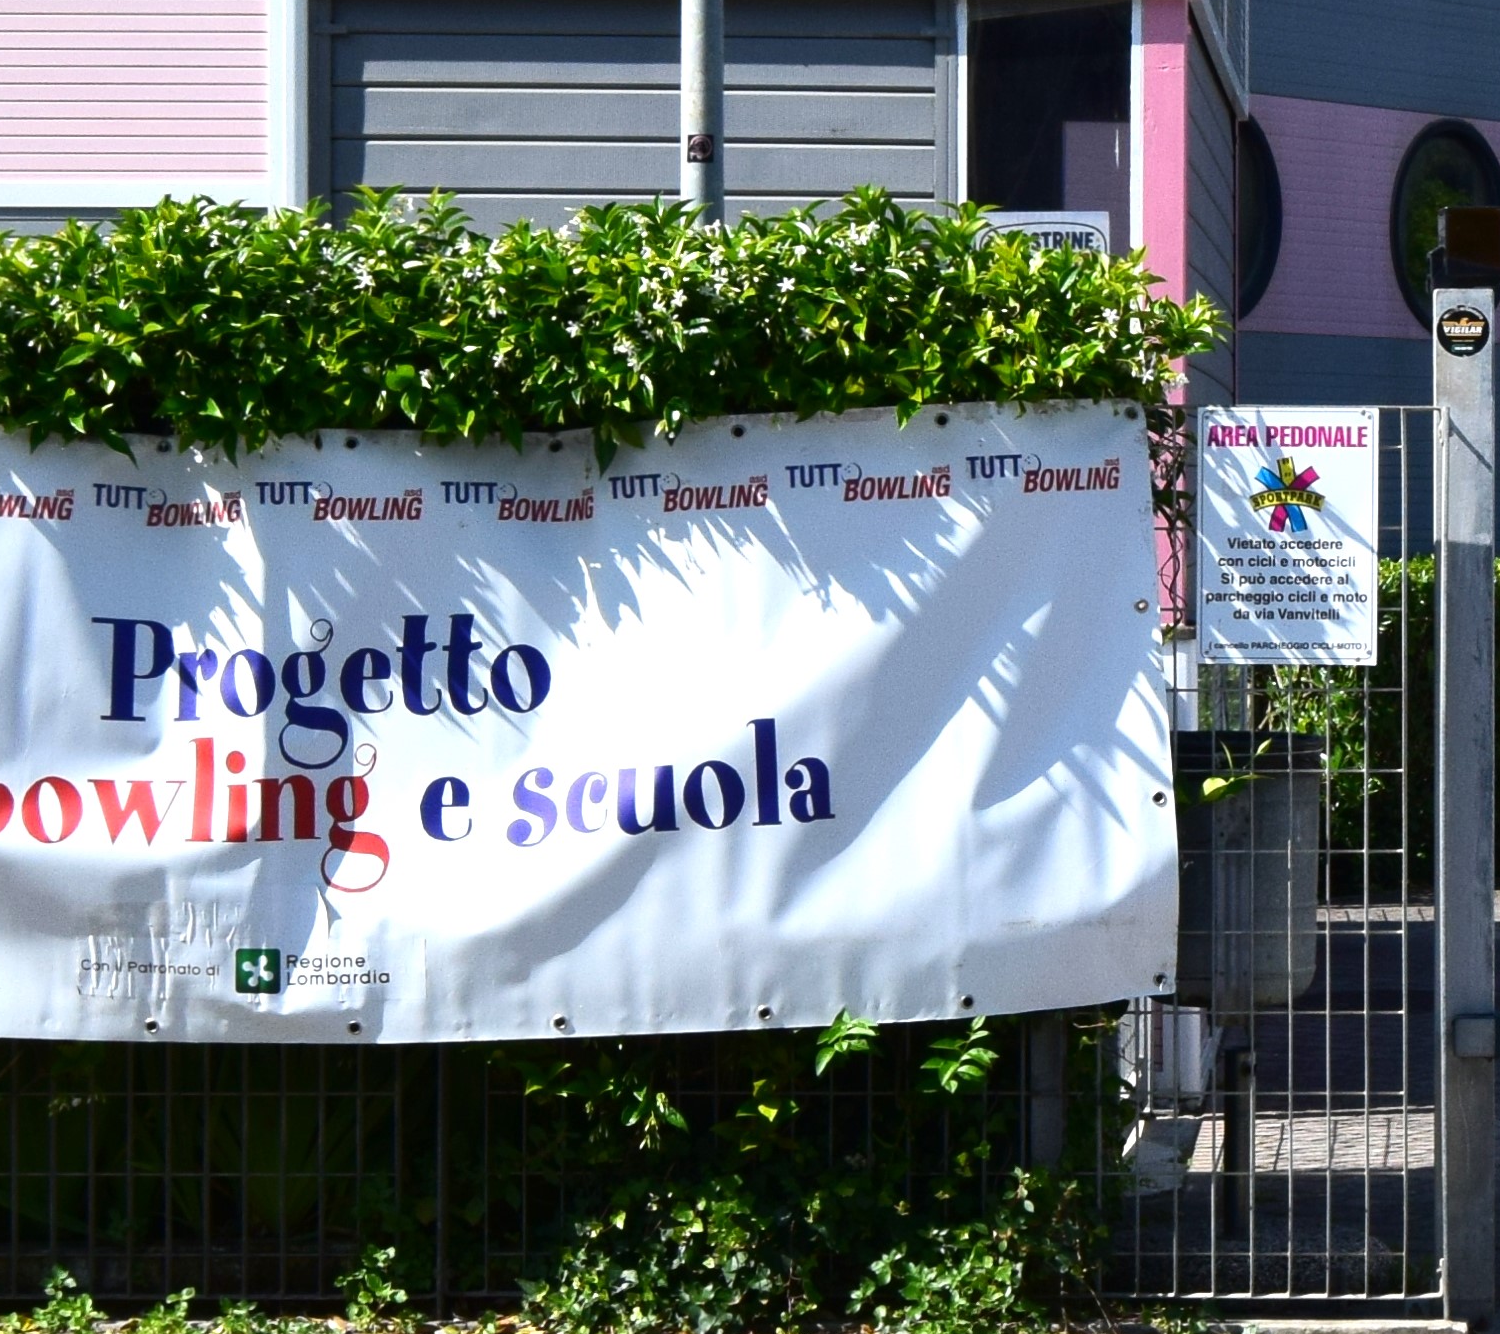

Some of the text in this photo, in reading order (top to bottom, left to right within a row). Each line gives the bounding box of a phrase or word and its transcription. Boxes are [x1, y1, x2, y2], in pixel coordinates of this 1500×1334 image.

[1021, 231, 1095, 251] STRNE
[1207, 425, 1368, 448] AREA PEDONALE
[843, 474, 951, 503] BOWLING
[1023, 467, 1121, 494] BOWLING
[662, 484, 769, 513] BOWLING
[1252, 490, 1322, 508] SPORTPARK
[146, 499, 242, 527] BOWLING
[313, 497, 423, 522] BOWLING
[498, 495, 594, 523] BOWLING
[1227, 538, 1343, 550] Vietato accedere
[1217, 555, 1356, 567] con cicli e motocicli
[1239, 572, 1265, 587] può
[1269, 573, 1333, 584] accedere
[1337, 573, 1349, 584] al
[1205, 591, 1368, 605] parcheggio cicli e moto
[1233, 608, 1340, 620] da via Vanvitelli
[90, 613, 552, 770] Progetto
[419, 775, 472, 842] e
[506, 718, 836, 848] scuola
[80, 958, 111, 973] Con
[127, 961, 201, 977] Patronato
[203, 964, 220, 977] di
[285, 954, 366, 973] Regione
[285, 970, 391, 987] Lombardia
